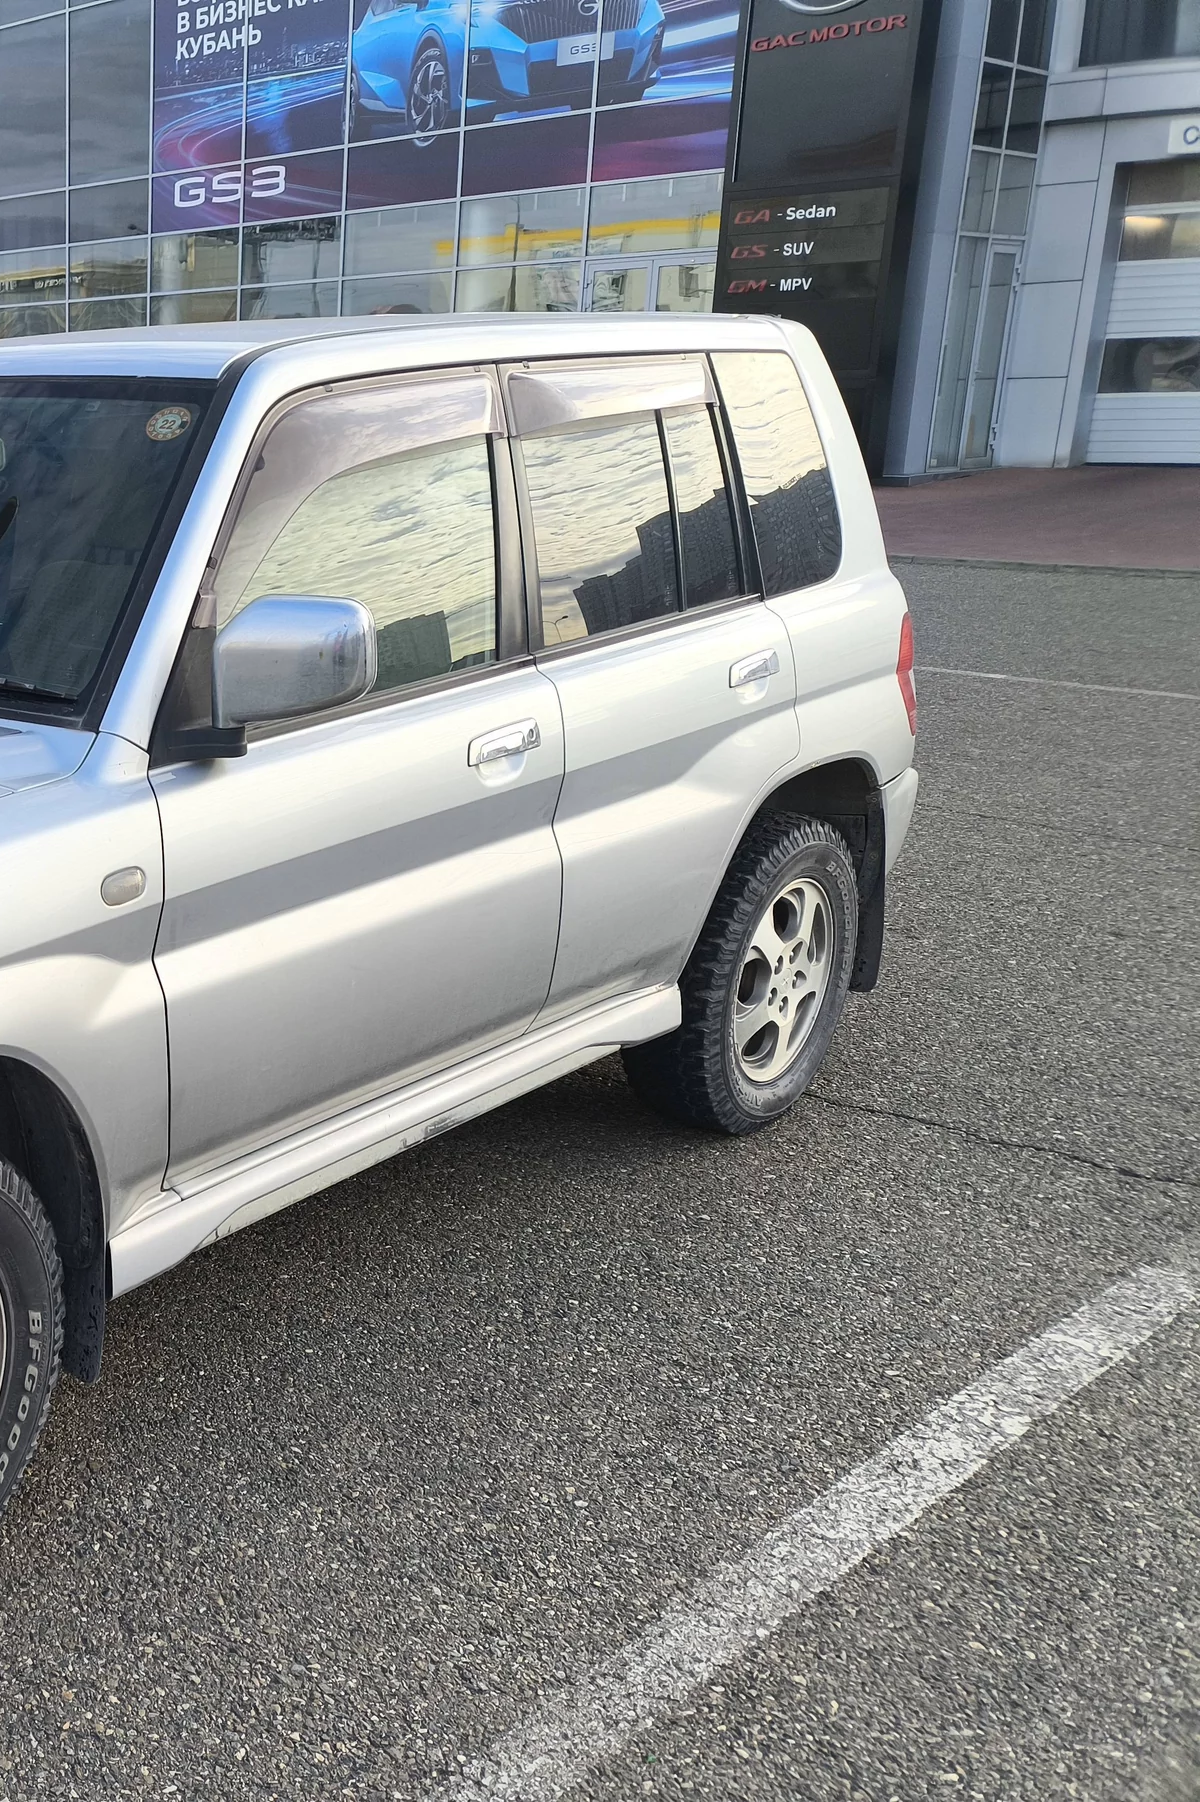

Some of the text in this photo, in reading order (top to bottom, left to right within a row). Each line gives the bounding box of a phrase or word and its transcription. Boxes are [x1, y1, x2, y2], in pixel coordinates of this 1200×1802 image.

[176, 0, 282, 34] В БИЗНЕС
[176, 23, 262, 61] КУБАНЬ
[750, 14, 908, 52] GAC MOTOR
[174, 165, 286, 208] GS3
[734, 209, 770, 225] GA
[786, 204, 837, 220] Sedan
[731, 244, 768, 259] GS
[782, 241, 814, 256] SUV
[727, 279, 768, 294] GM
[779, 277, 813, 292] MPV
[159, 419, 177, 430] 22
